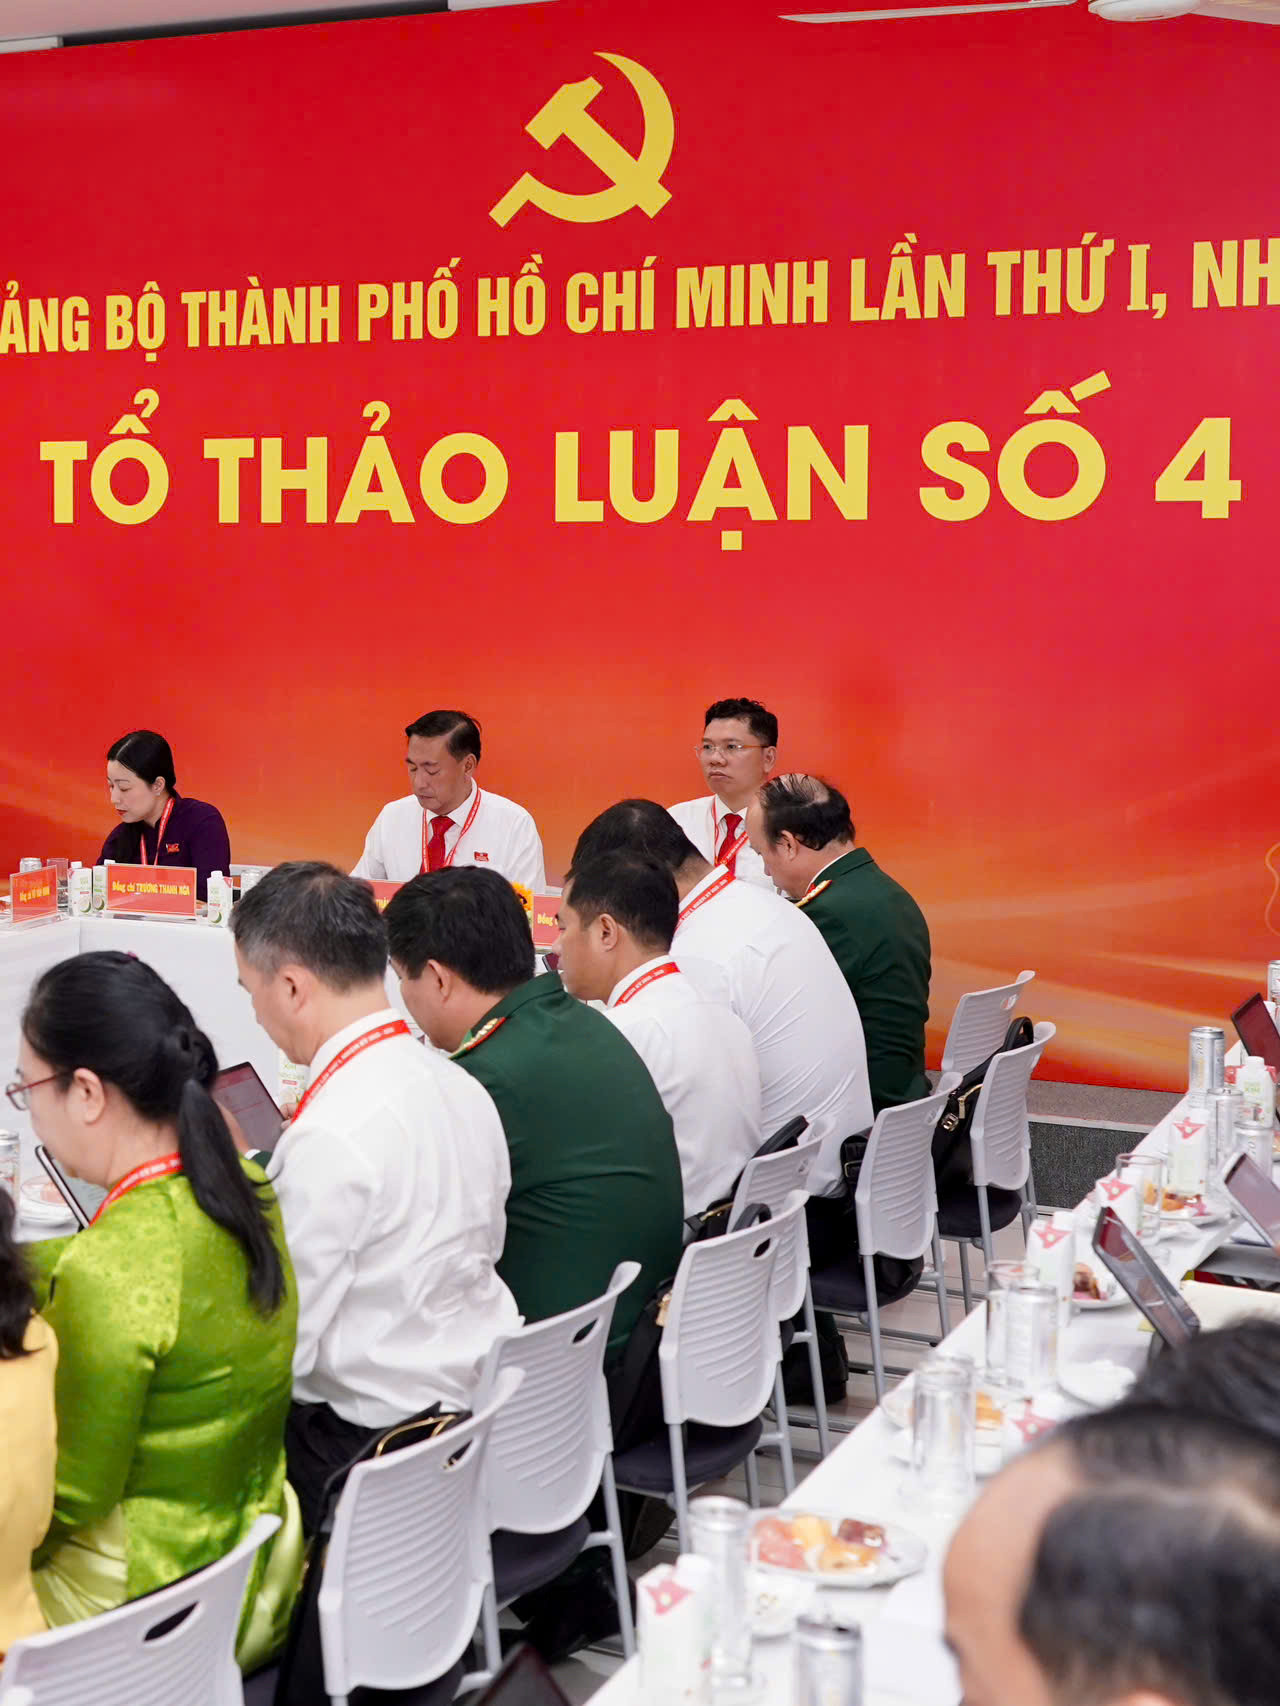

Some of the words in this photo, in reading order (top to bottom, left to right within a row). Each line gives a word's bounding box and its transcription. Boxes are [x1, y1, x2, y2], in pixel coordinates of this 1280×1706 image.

[105, 281, 166, 361] BỘ
[180, 277, 340, 348] THÀNH
[358, 257, 461, 342] PHỐ
[477, 254, 546, 337] HỒ
[565, 256, 657, 334] CHÍ
[676, 256, 829, 329] MINH
[850, 233, 966, 322] LẦN
[987, 232, 1115, 316] THỨ
[1126, 243, 1167, 319] I,
[1192, 237, 1280, 309] NH
[39, 388, 170, 525] TỔ
[203, 400, 509, 525] THẢO
[554, 398, 869, 551] LUẬN
[919, 370, 1112, 522] SỐ
[1154, 417, 1242, 519] 4
